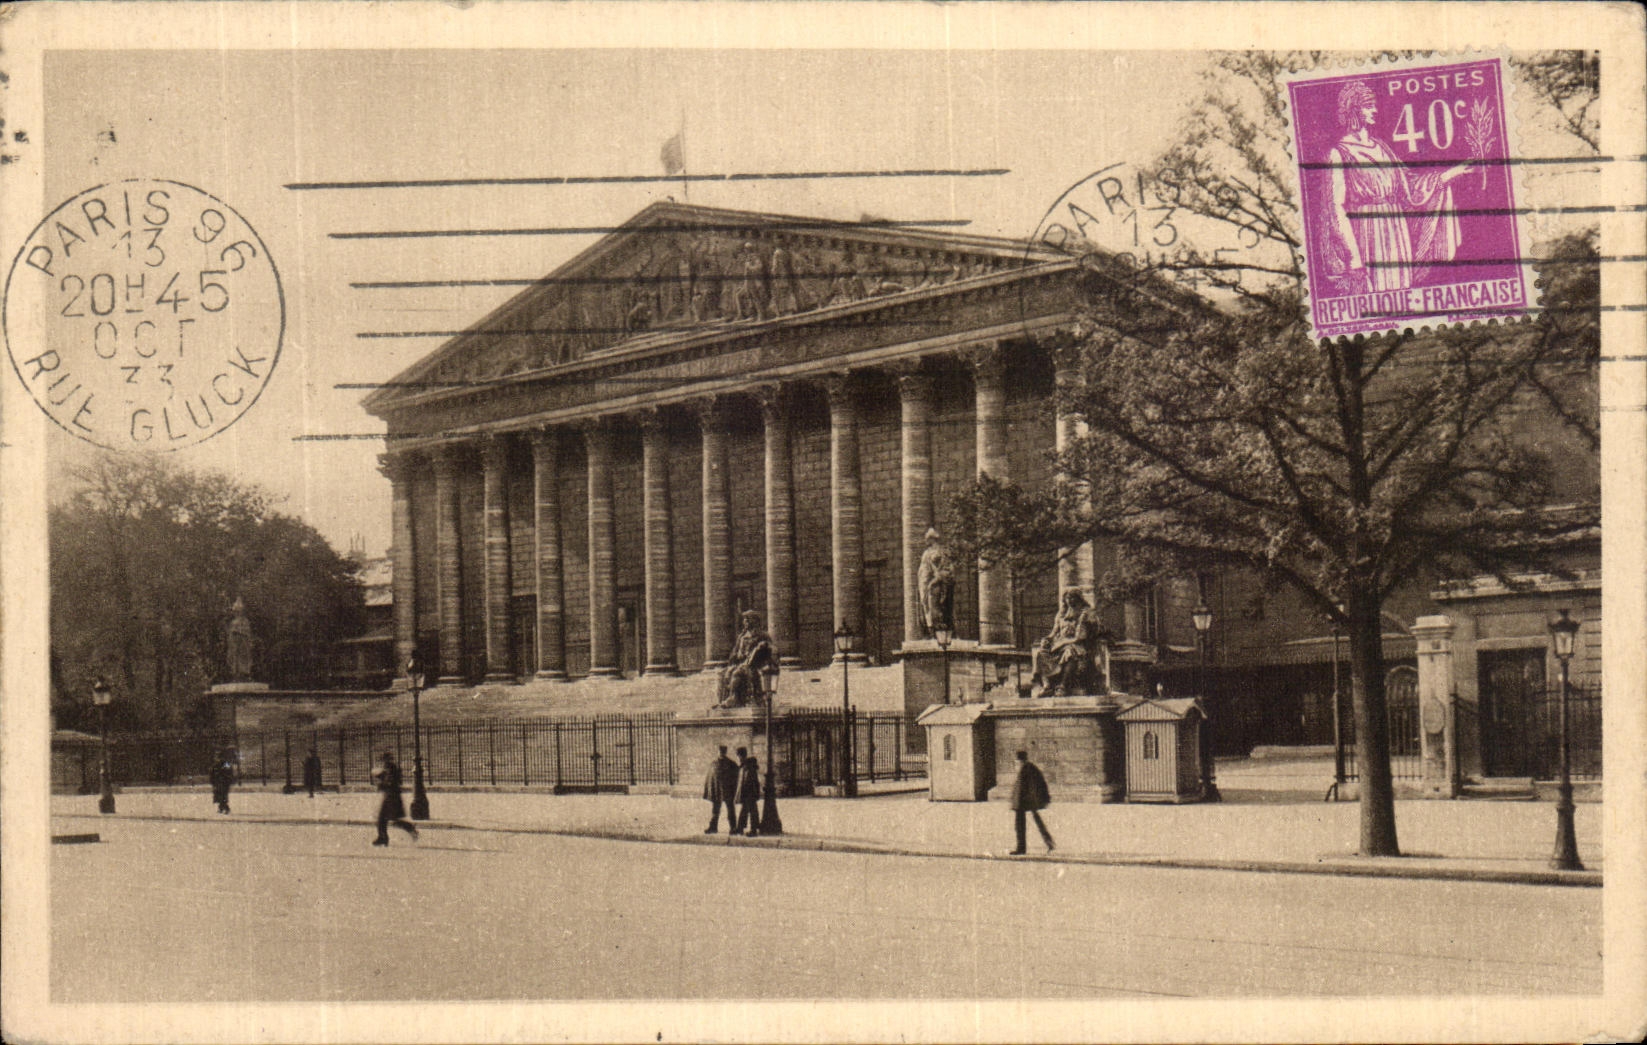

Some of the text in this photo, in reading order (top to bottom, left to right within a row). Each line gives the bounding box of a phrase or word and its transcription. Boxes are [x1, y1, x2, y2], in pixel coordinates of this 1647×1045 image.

[1388, 69, 1485, 96] POSTES
[1041, 168, 1181, 252] PARIS
[1121, 206, 1178, 247] 13
[25, 189, 257, 277] PARIS 96
[112, 227, 165, 267] 13
[94, 319, 195, 359] OCT
[24, 347, 266, 442] RUE GLUCK
